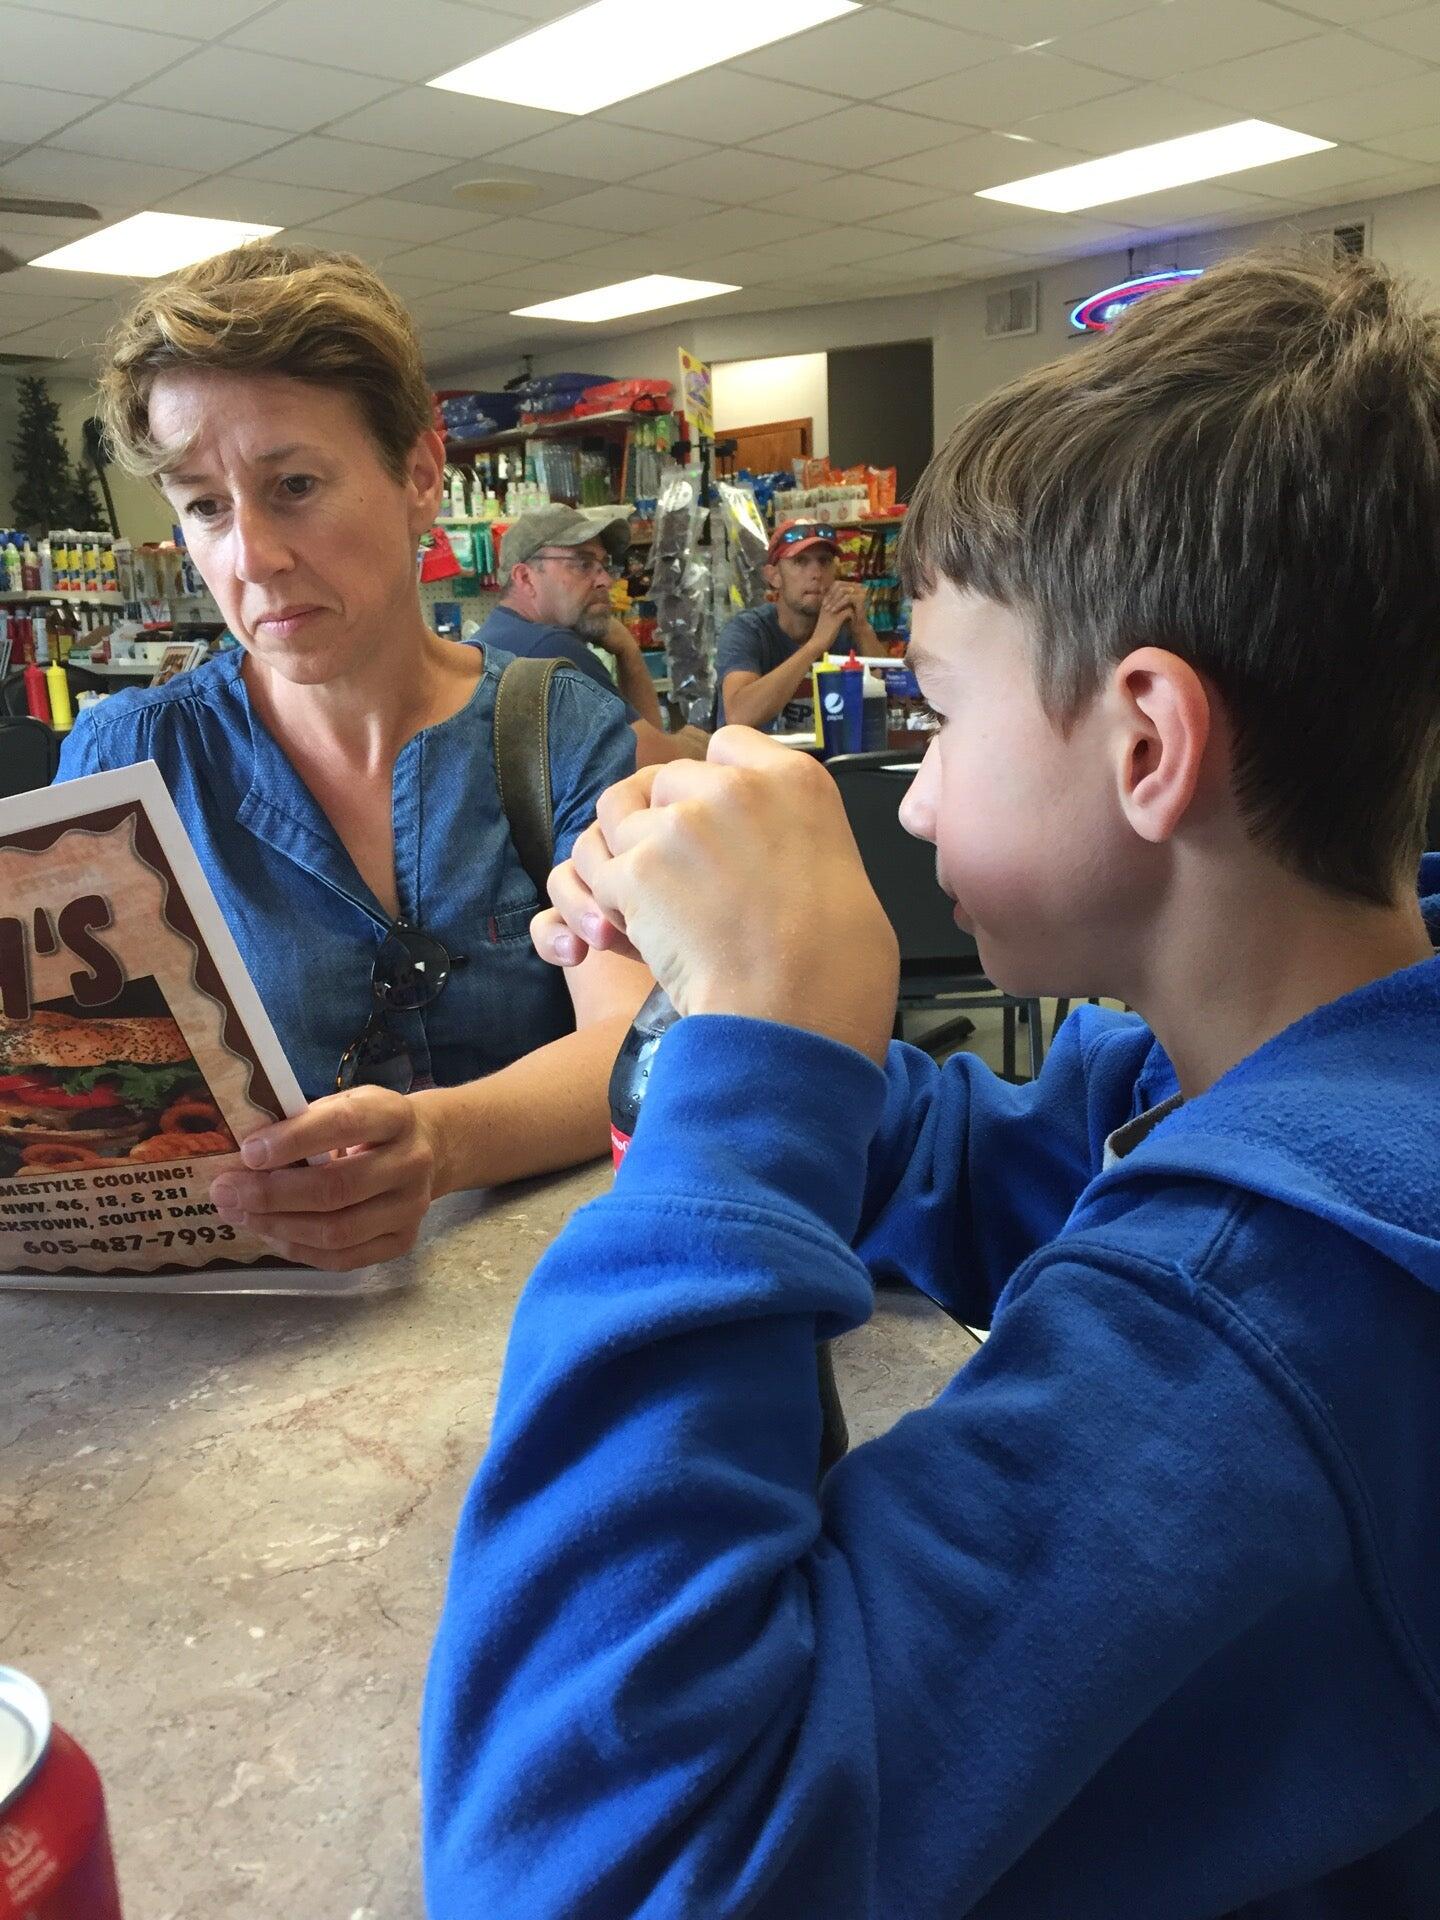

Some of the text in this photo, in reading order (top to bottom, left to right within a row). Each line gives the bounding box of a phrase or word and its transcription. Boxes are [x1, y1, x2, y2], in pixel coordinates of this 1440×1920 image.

[93, 1166, 194, 1189] COOKING!
[0, 1187, 188, 1214] HWY. 46, 18, & 281
[98, 1209, 162, 1227] SOUTH
[23, 1224, 236, 1255] 605-487-7993
